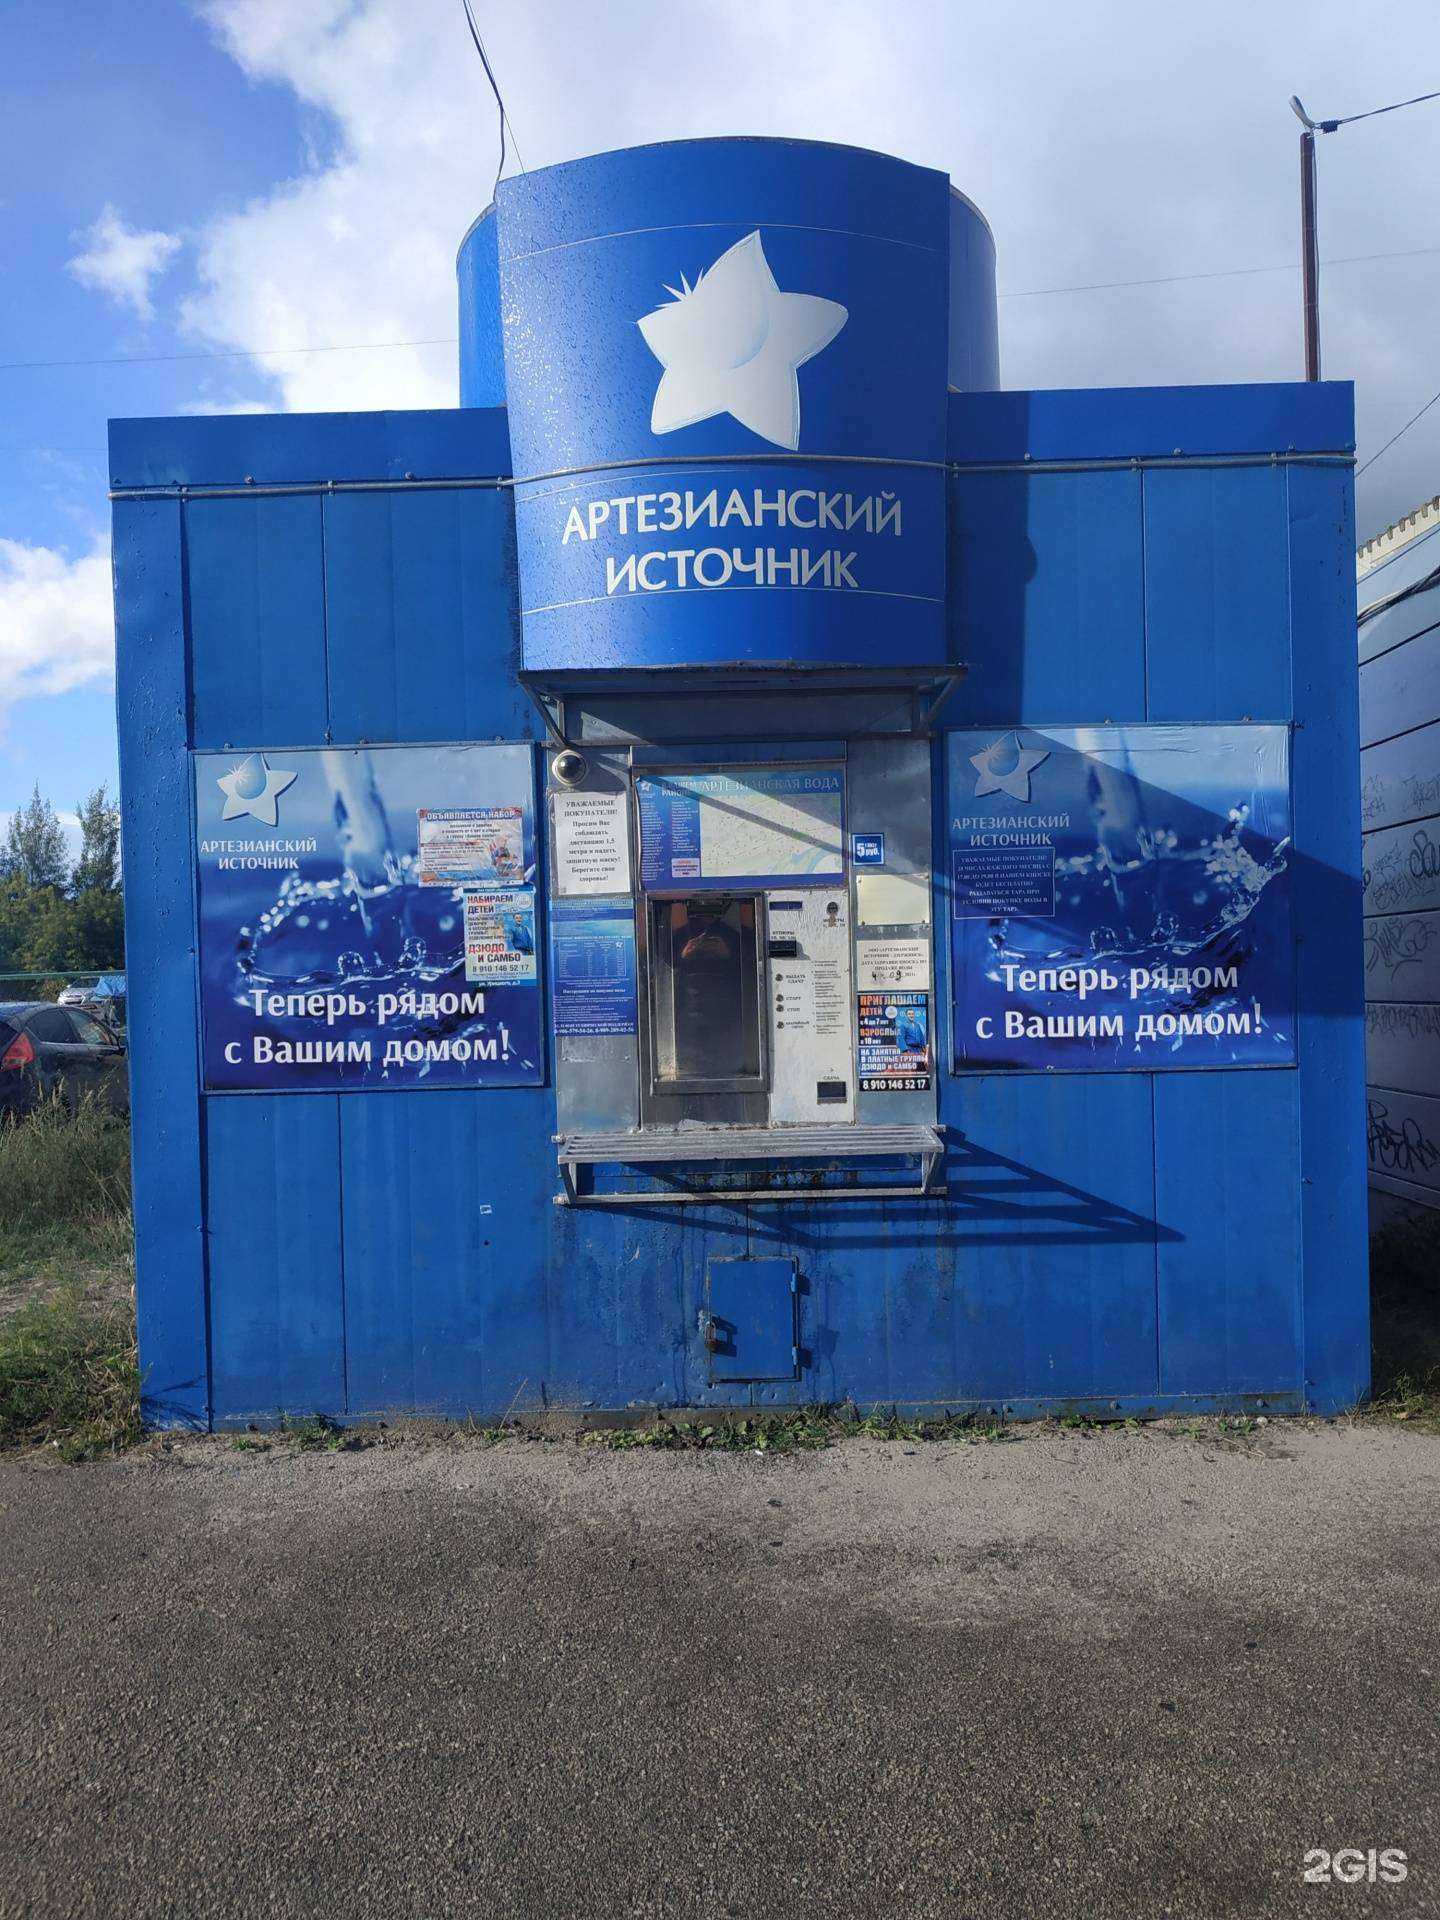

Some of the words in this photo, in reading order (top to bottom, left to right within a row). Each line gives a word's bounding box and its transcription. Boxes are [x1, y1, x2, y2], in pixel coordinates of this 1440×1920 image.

[562, 489, 902, 545] АРТЕЗИАНСКИЙ
[606, 548, 859, 595] ИСТОЧНИК
[804, 776, 839, 790] ВОДА
[566, 800, 614, 808] УВАЖАЕМЫЕ
[427, 811, 488, 821] ОБЪЯВЛЯЕТСЯ
[488, 810, 516, 820] НАБОР
[952, 811, 1070, 830] АРТЕЗИАНСКИЙ
[200, 837, 317, 853] АРТЕЗИАНСКИЙ
[970, 832, 1052, 847] ИСТОЧНИК
[856, 843, 864, 857] 5
[218, 856, 300, 871] ИСТОЧНИК
[467, 894, 513, 904] НАБИРАЕМ
[467, 905, 494, 915] ДЕТЕЙ
[468, 943, 504, 954] ДЗЮДО
[478, 954, 484, 963] И
[487, 953, 521, 963] САМБО
[480, 965, 492, 973] 910
[509, 964, 519, 972] 52
[1000, 964, 1119, 1000] Теперь
[1130, 965, 1239, 1000] рядом
[249, 988, 367, 1026] Теперь
[377, 991, 486, 1026] рядом
[860, 994, 926, 1006] ПРИГЛАШАЕМ
[860, 1007, 883, 1017] ДЕТЕЙ
[975, 1016, 994, 1039] с
[1005, 1011, 1124, 1039] Вашим
[1135, 1003, 1263, 1042] домом!
[224, 1042, 242, 1065] с
[253, 1036, 372, 1064] Вашим
[383, 1029, 510, 1068] домом!
[861, 1063, 887, 1071] ДЗЮДО
[893, 1063, 917, 1071] САМБО
[862, 1080, 869, 1090] 8
[871, 1080, 886, 1090] 910
[888, 1080, 903, 1089] 146
[905, 1079, 915, 1089] 52
[917, 1079, 926, 1089] 17
